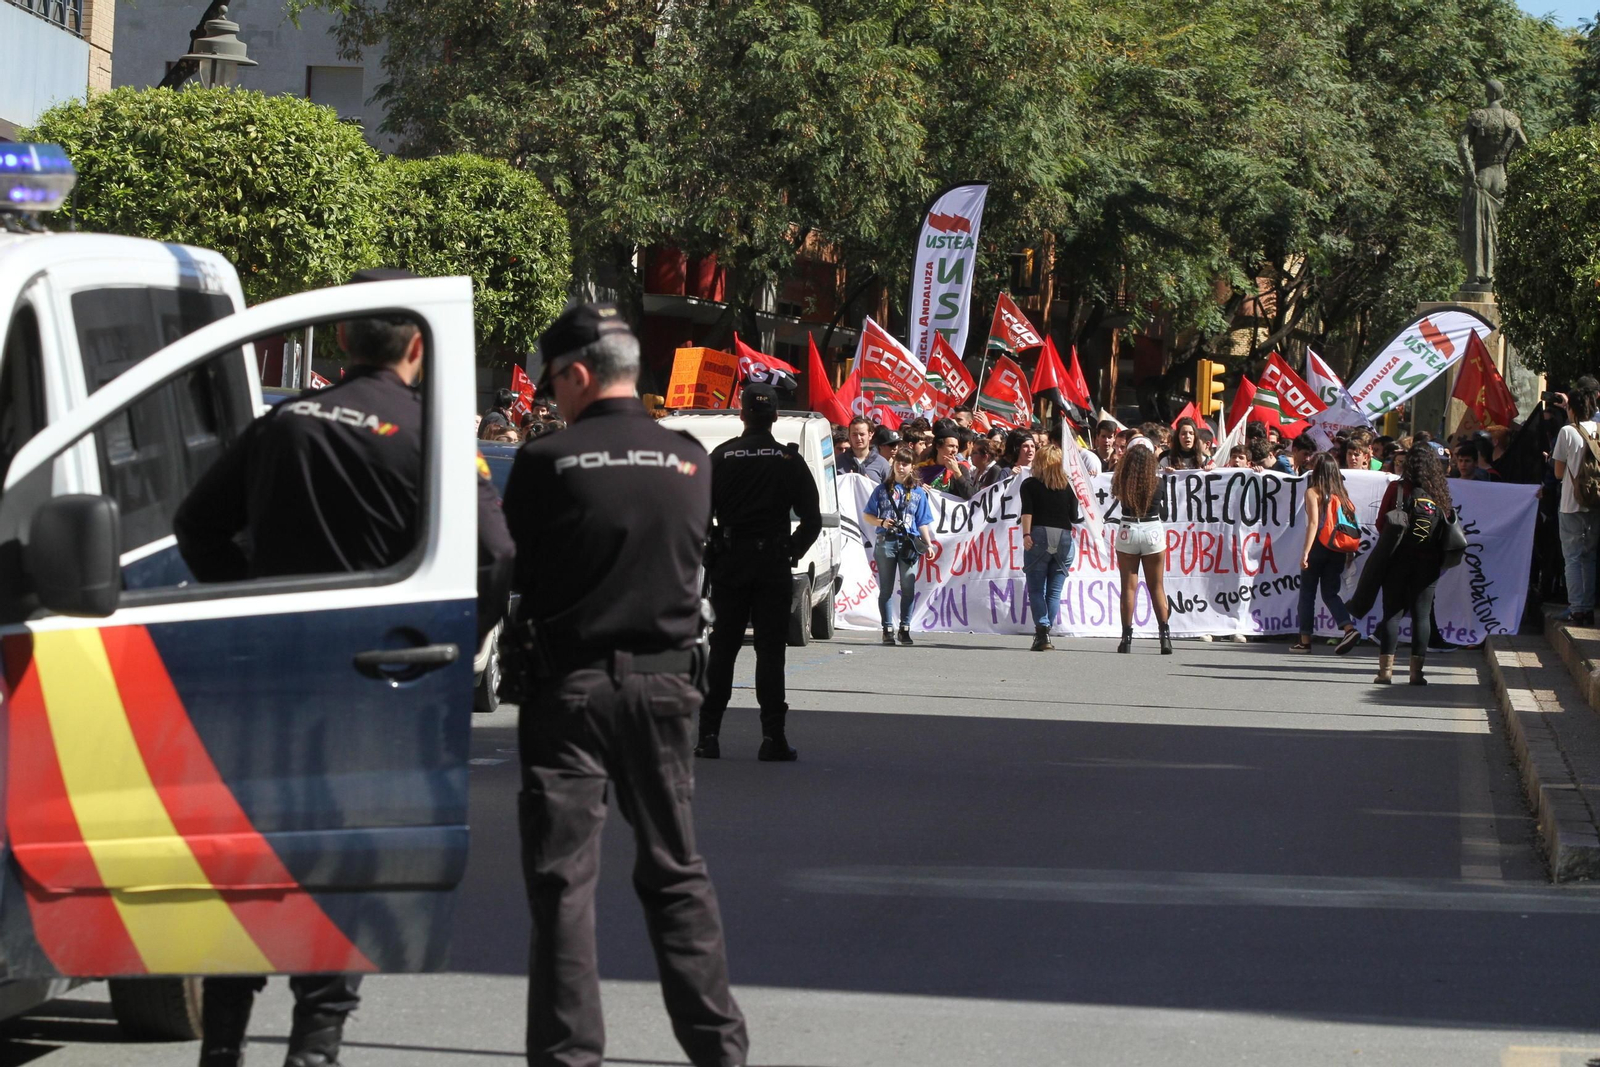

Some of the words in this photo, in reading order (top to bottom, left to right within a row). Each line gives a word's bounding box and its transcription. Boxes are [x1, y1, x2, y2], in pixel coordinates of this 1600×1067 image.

[925, 235, 975, 250] USTEA
[918, 261, 934, 328] ANDALUZA
[739, 356, 785, 386] CGT
[864, 344, 924, 390] CCOO
[1403, 334, 1447, 374] USTEA
[1262, 363, 1320, 418] CCOO
[1352, 356, 1401, 405] ANDALUZA
[274, 401, 381, 431] POLICIA
[554, 450, 682, 475] POLICIA
[724, 448, 784, 460] POLICIA
[950, 529, 1002, 577] UNA
[1166, 523, 1278, 576] PÚBLICA
[922, 584, 969, 630] SIN
[1167, 591, 1208, 614] Nos
